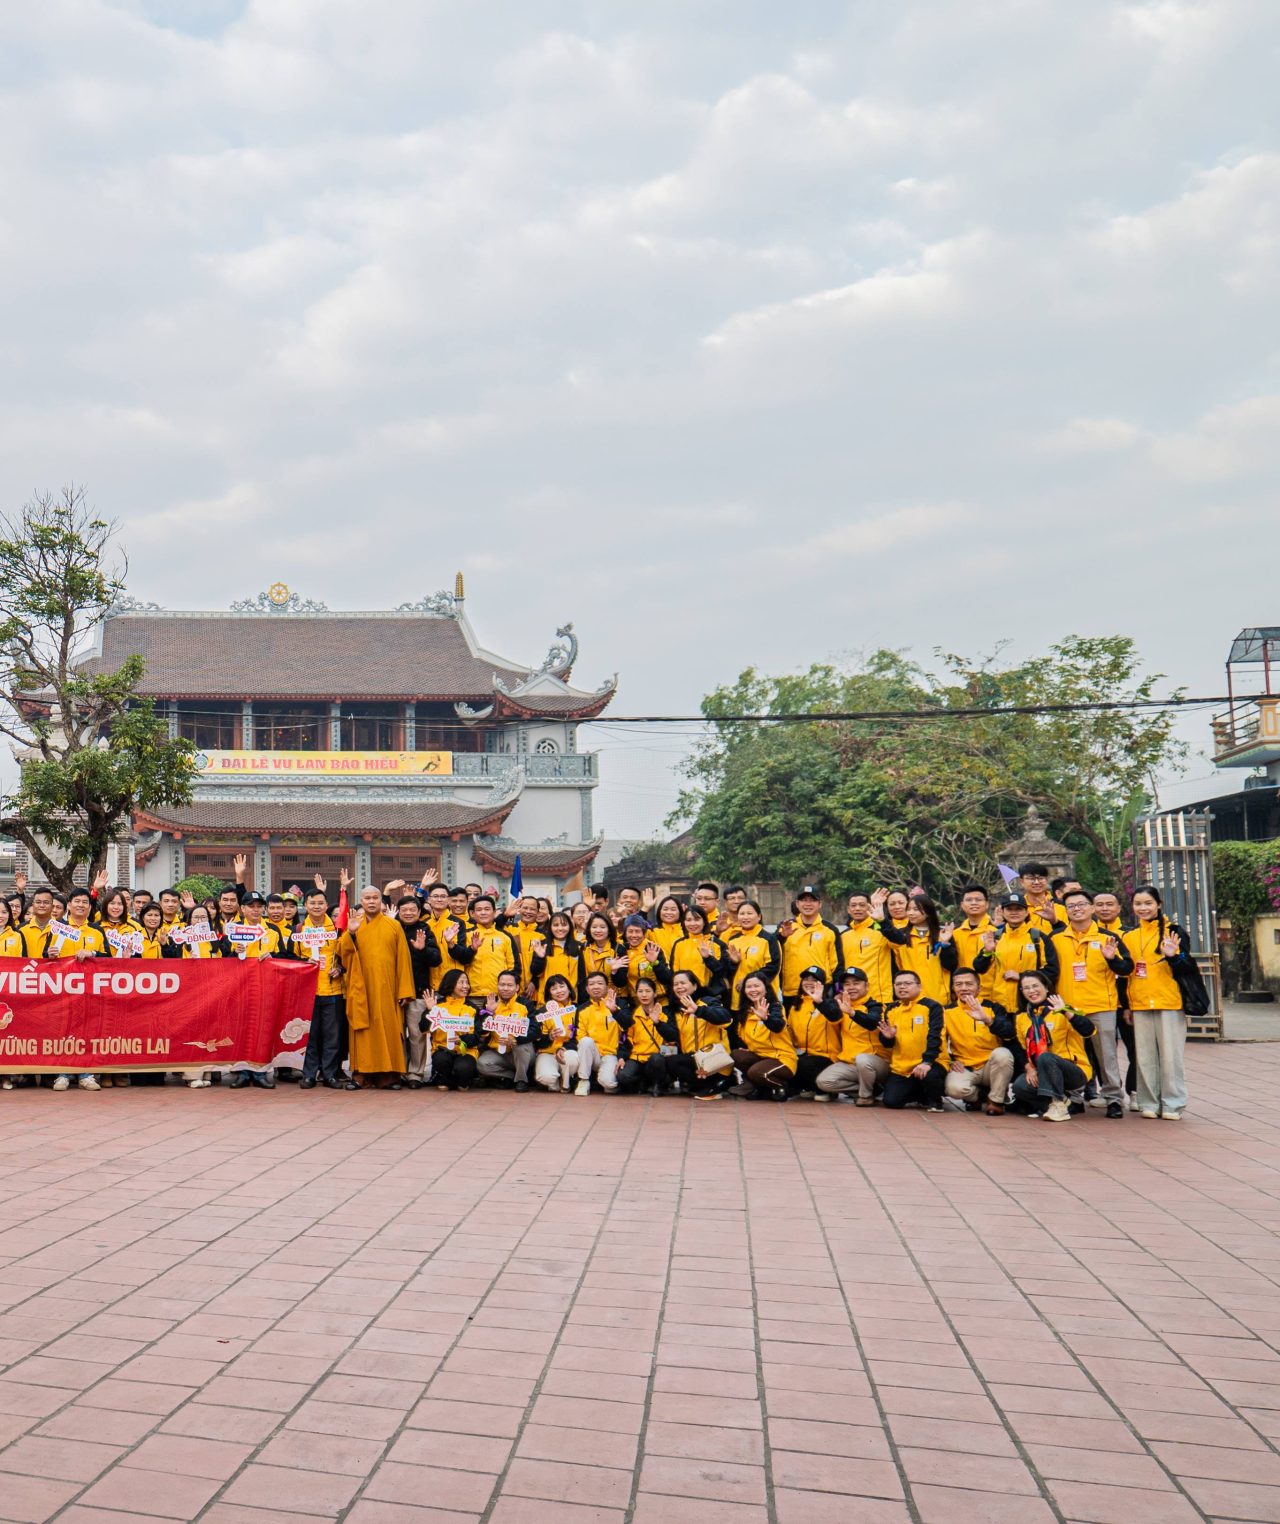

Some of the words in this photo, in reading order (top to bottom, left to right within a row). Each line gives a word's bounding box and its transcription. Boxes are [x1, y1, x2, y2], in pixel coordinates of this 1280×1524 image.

[296, 758, 326, 769] LAN
[93, 972, 180, 995] FOOD
[43, 1035, 86, 1055] BƯỚC
[91, 1036, 142, 1055] TƯƠNG
[147, 1039, 170, 1055] LAI
